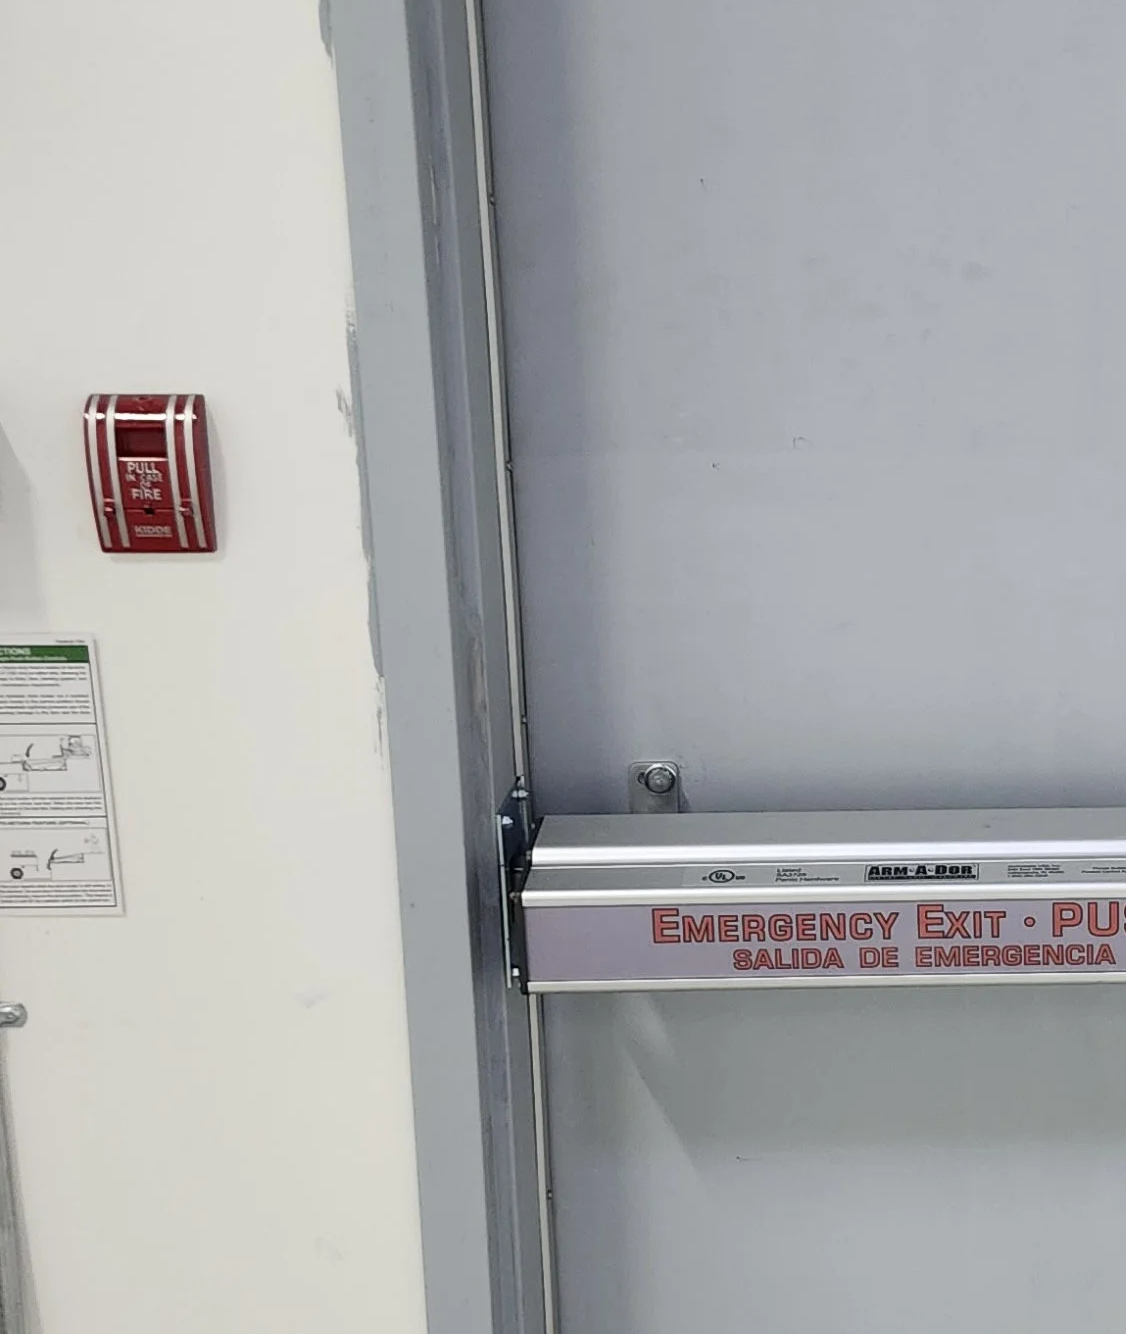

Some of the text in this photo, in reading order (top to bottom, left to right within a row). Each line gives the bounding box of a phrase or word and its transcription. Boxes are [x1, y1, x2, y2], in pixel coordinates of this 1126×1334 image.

[127, 461, 160, 474] PULL
[131, 488, 163, 500] FIRE
[651, 907, 900, 944] EMERGENCY
[916, 903, 1007, 940] EXIT
[732, 943, 1117, 971] SALIDA DE EMERGENCIA
